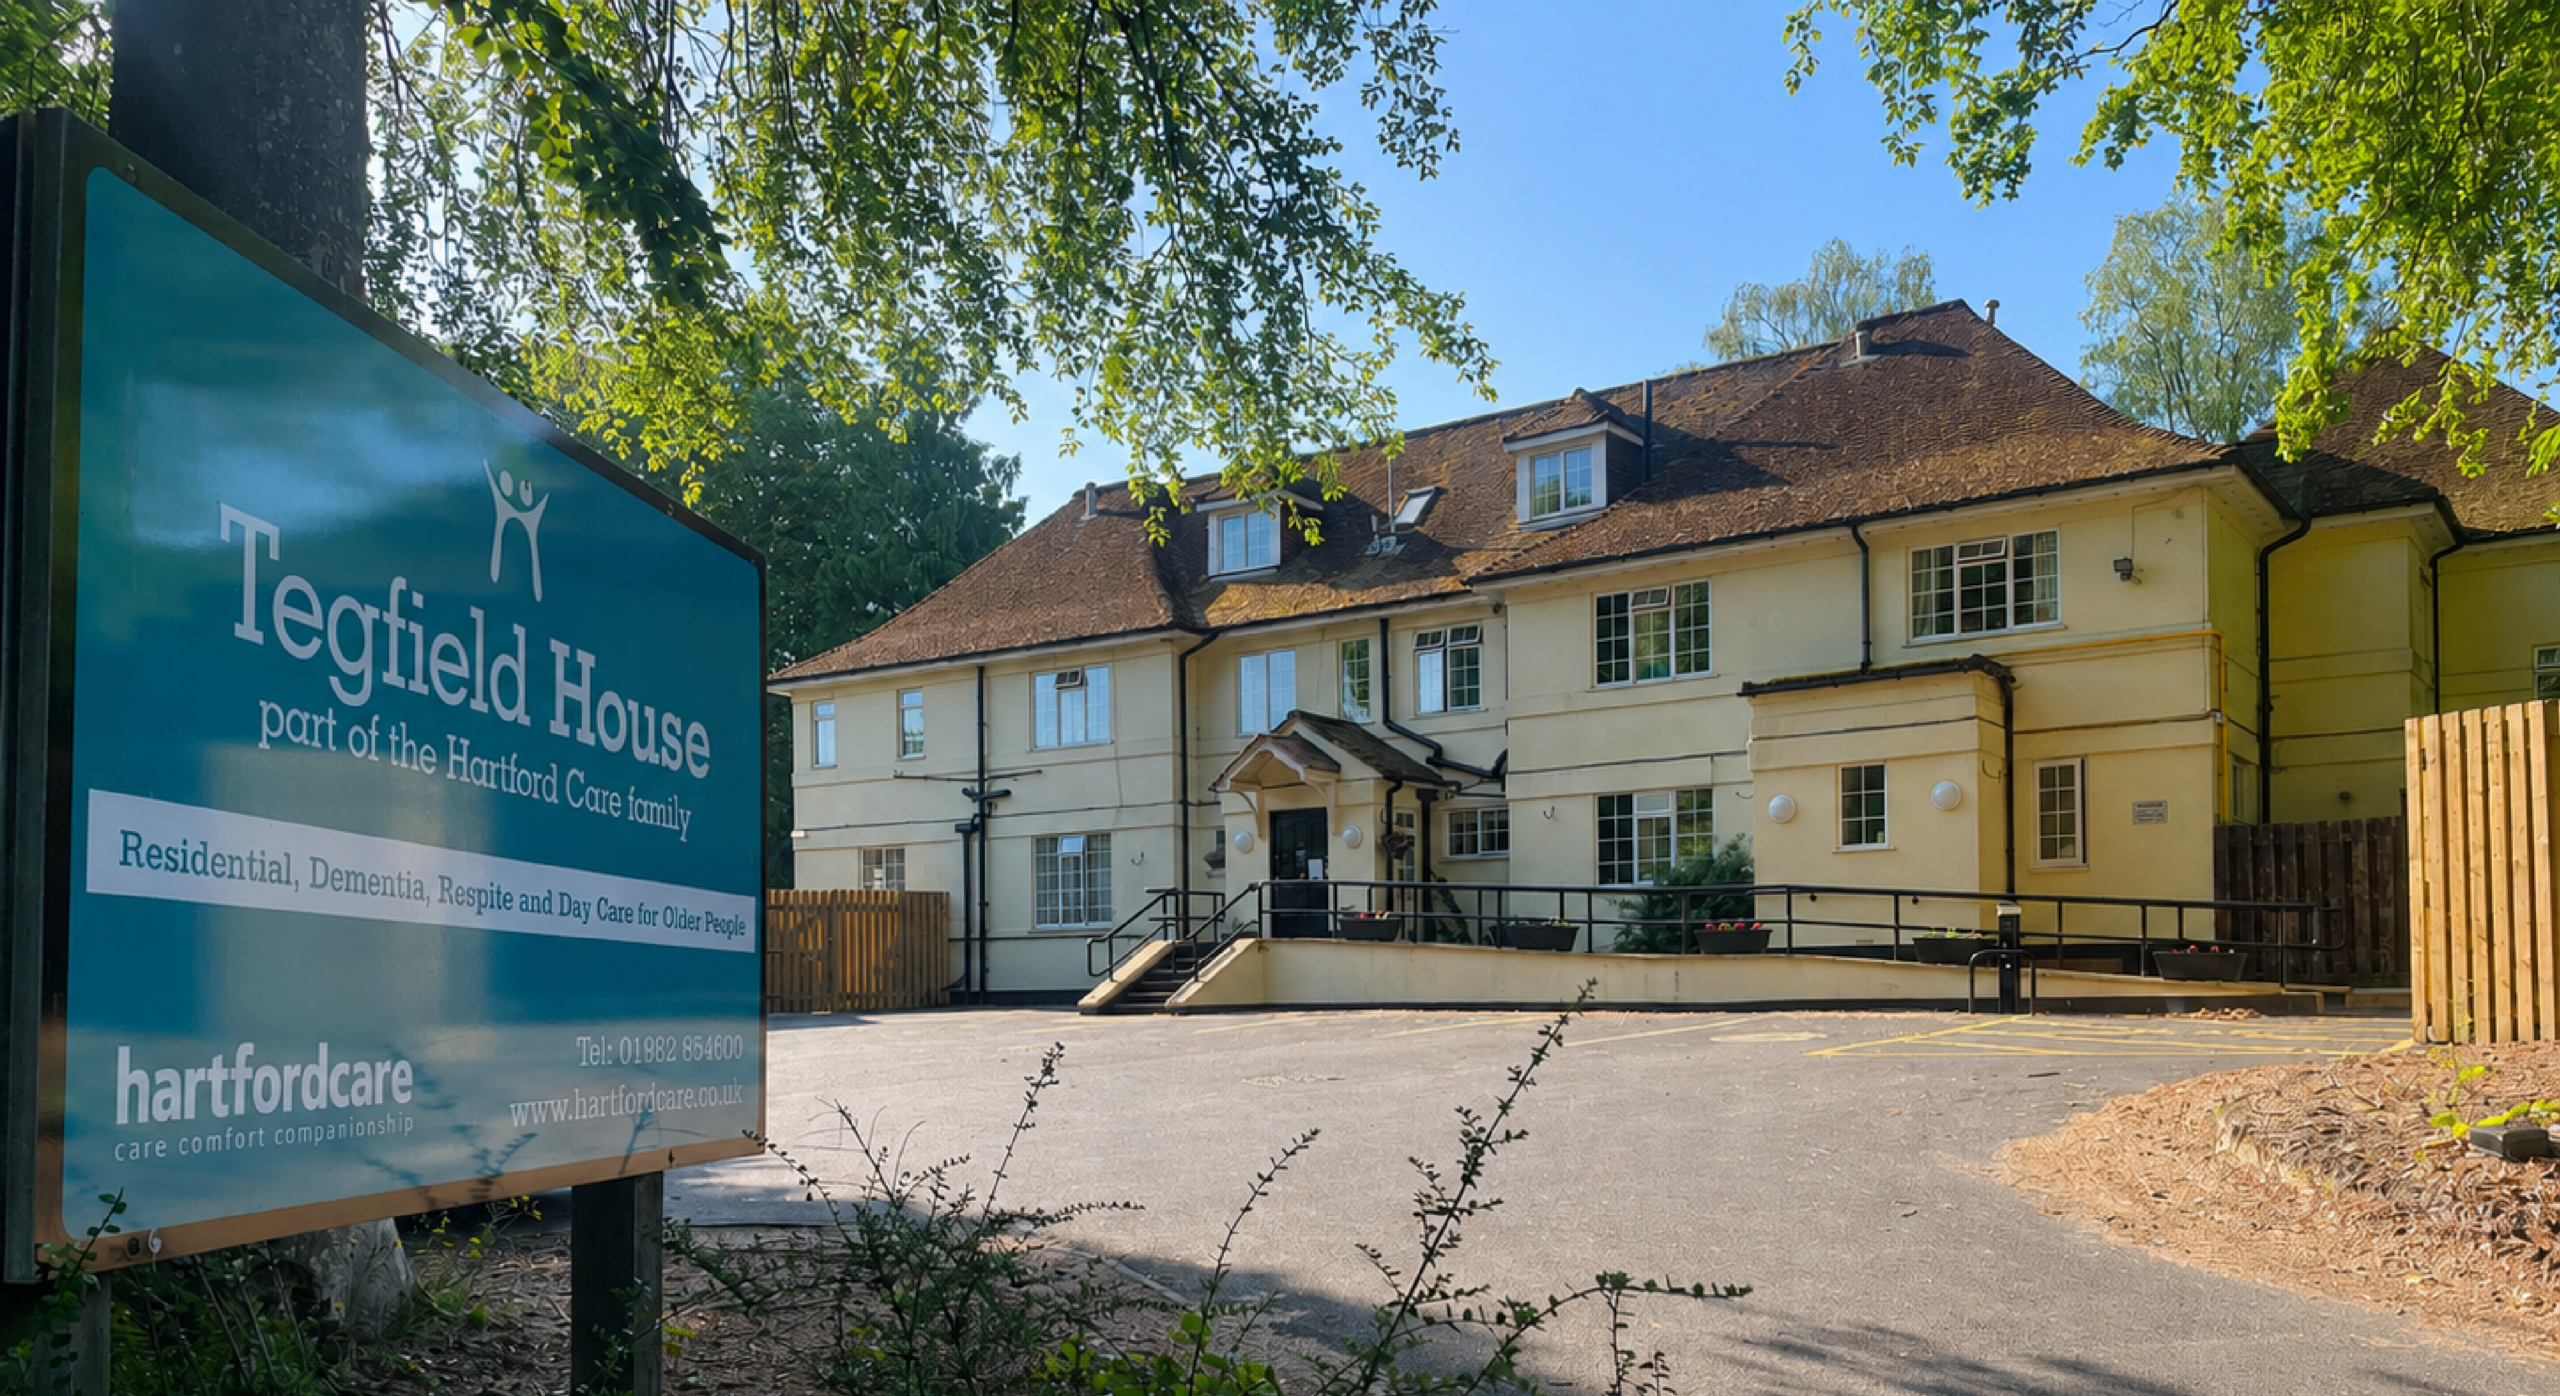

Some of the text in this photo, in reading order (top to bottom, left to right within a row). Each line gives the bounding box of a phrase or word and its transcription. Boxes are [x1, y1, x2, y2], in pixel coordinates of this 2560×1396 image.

[219, 502, 711, 779] Tegfield House
[258, 700, 692, 842] part of the Hartford Care family
[119, 829, 746, 940] Residential, Dementia, Respite and Day Care for Older People
[116, 1042, 414, 1126] hartfordcare
[576, 1035, 613, 1067] Tel:
[114, 1112, 414, 1162] care comfort companionship
[509, 1077, 744, 1127] www.hartfordcare.co.uk
